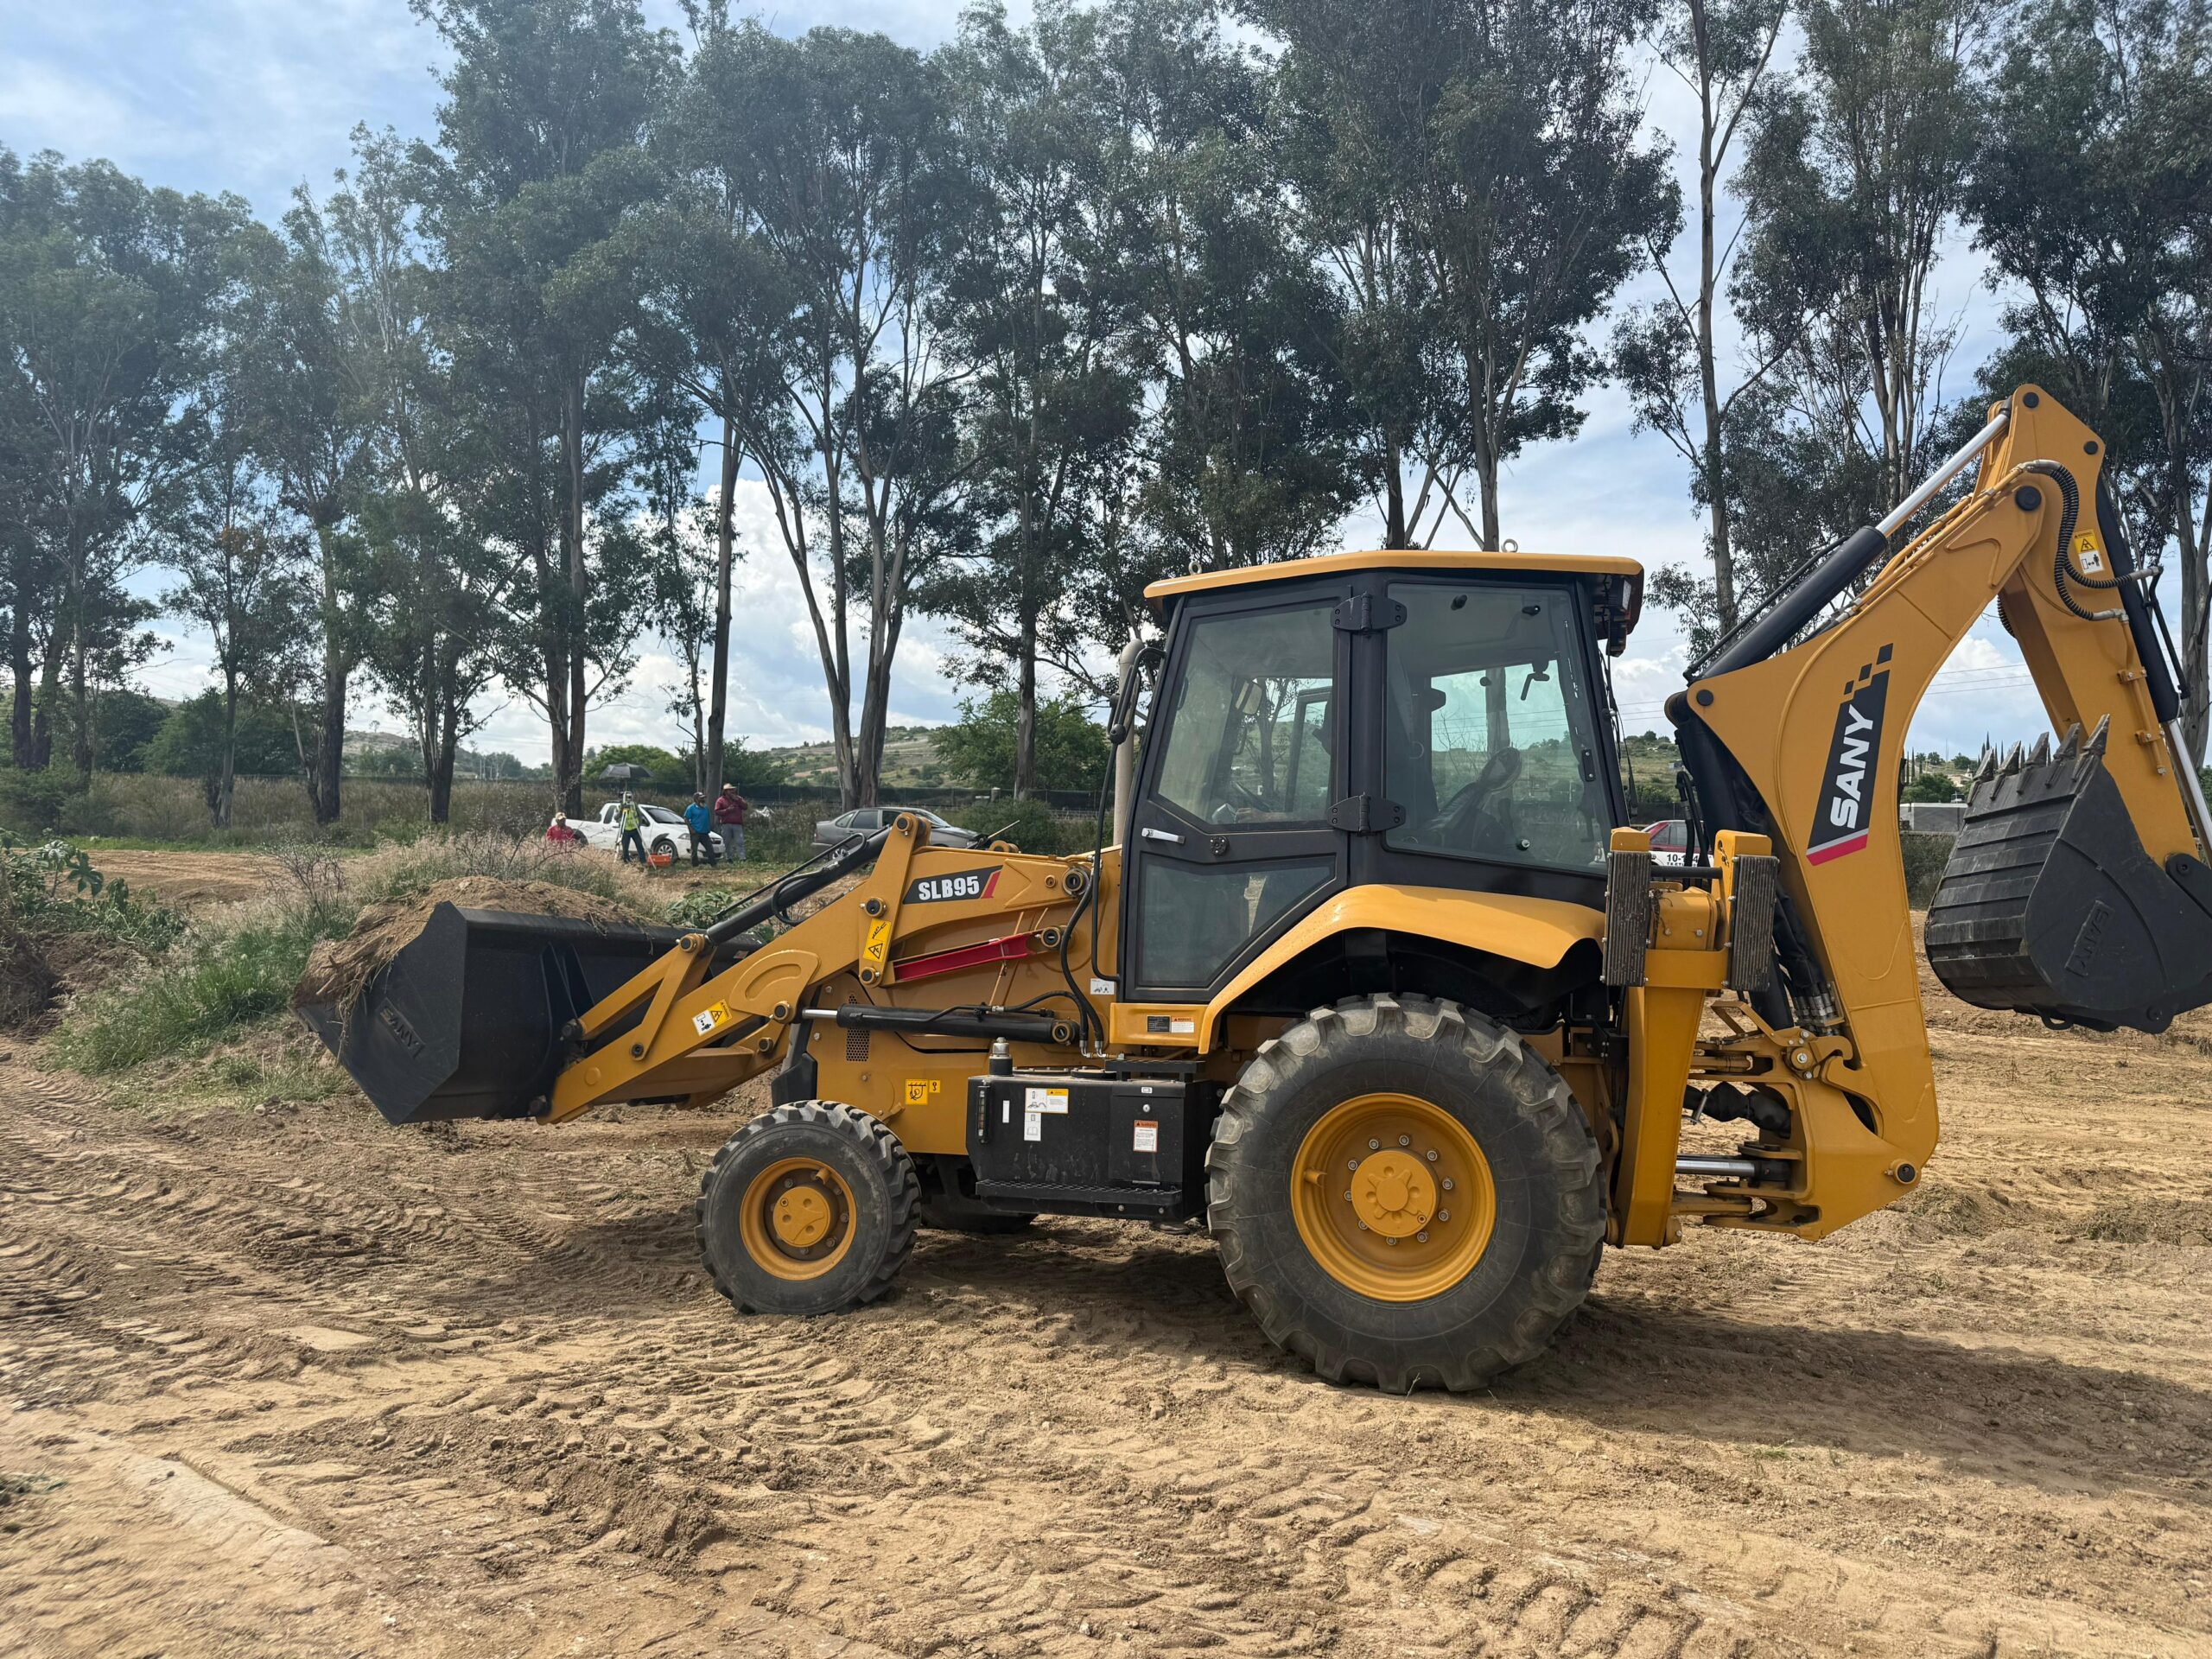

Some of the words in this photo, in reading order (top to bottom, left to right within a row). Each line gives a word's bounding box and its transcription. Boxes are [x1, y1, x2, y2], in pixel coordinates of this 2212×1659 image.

[1830, 703, 1873, 829] SANY
[918, 875, 980, 900] SLB95
[380, 1007, 421, 1054] SANY
